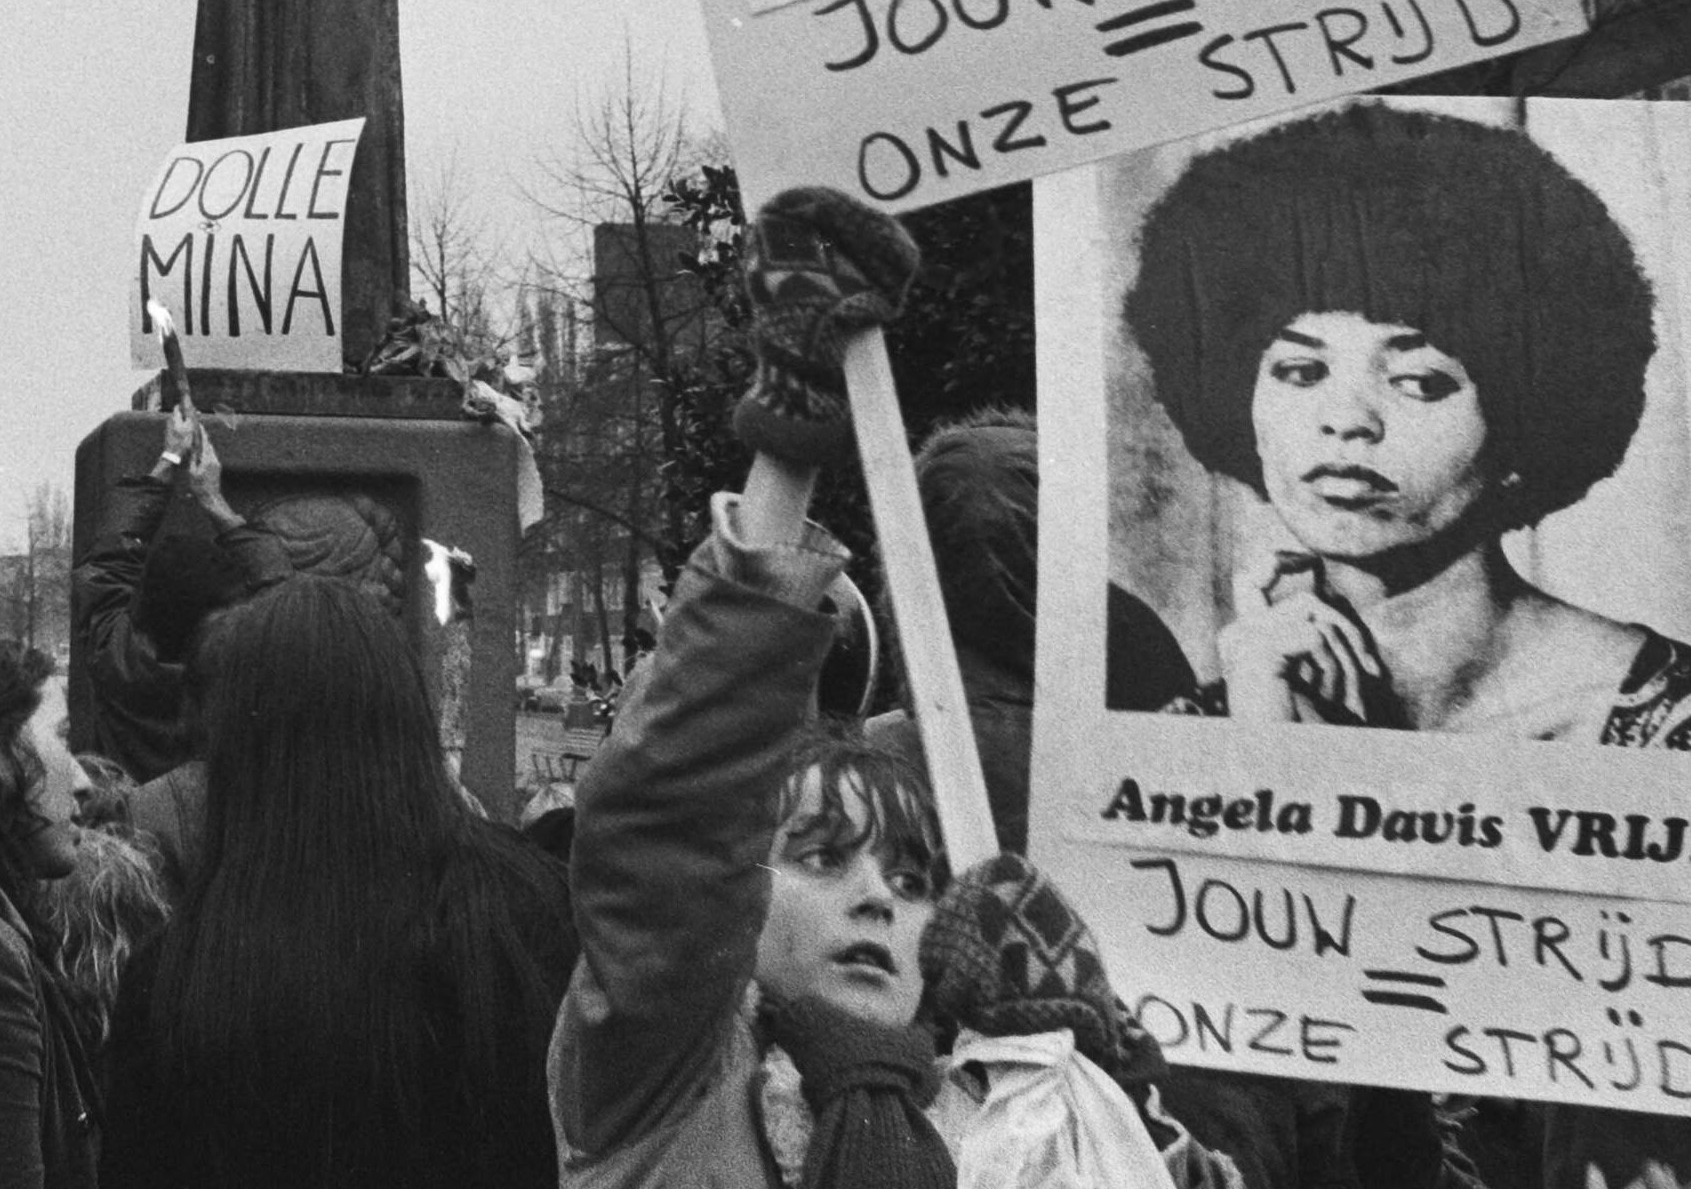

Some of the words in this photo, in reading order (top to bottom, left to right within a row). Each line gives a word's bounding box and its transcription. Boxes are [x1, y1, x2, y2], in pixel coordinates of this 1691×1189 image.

[149, 138, 356, 220] DOLLE
[857, 76, 1119, 201] ONZE
[140, 232, 335, 337] MINA
[1101, 777, 1313, 837] Angela
[1333, 794, 1504, 848] Davis
[1528, 806, 1691, 863] VRIJ
[1130, 858, 1355, 957] JOUW
[1136, 995, 1357, 1063] ONZE
